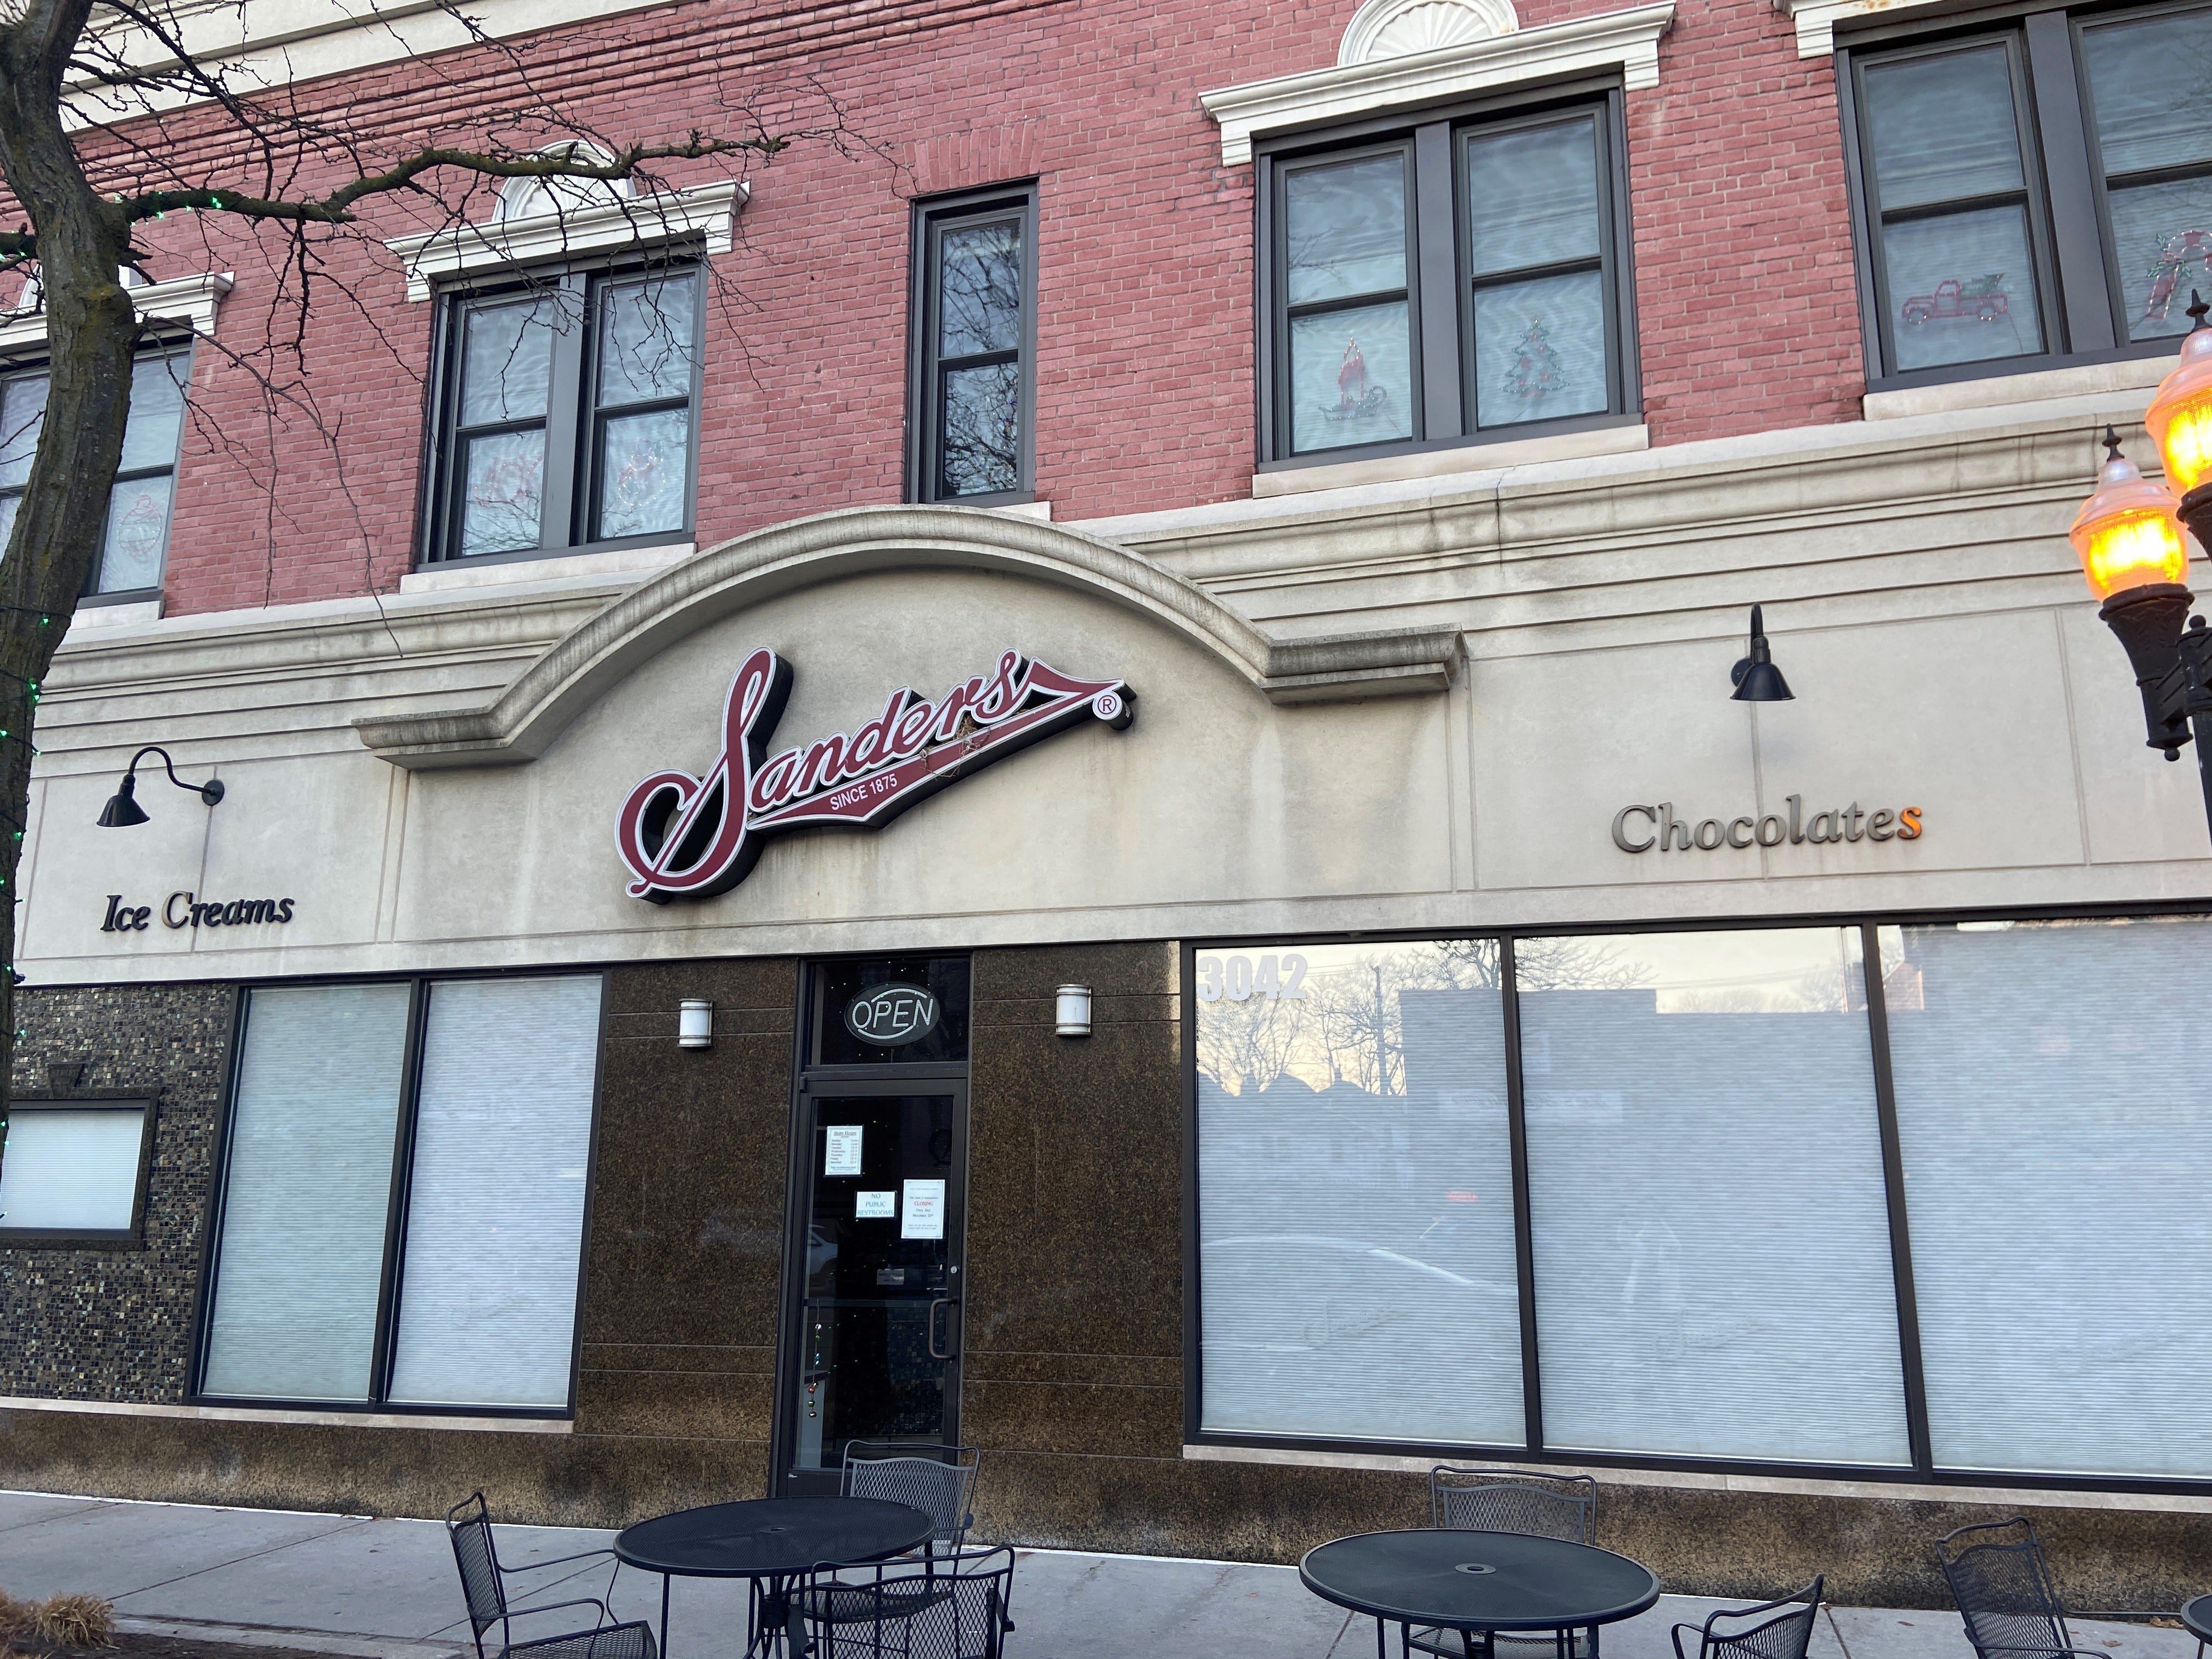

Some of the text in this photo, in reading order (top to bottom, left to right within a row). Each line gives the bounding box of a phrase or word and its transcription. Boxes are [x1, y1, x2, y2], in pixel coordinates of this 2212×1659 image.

[615, 646, 1125, 898] Sanders
[830, 773, 898, 810] SINCE 1875
[1612, 793, 1922, 853] Chocolates
[100, 890, 295, 932] Ice Creams
[1196, 953, 1308, 1002] 3042
[852, 998, 933, 1029] OPEN
